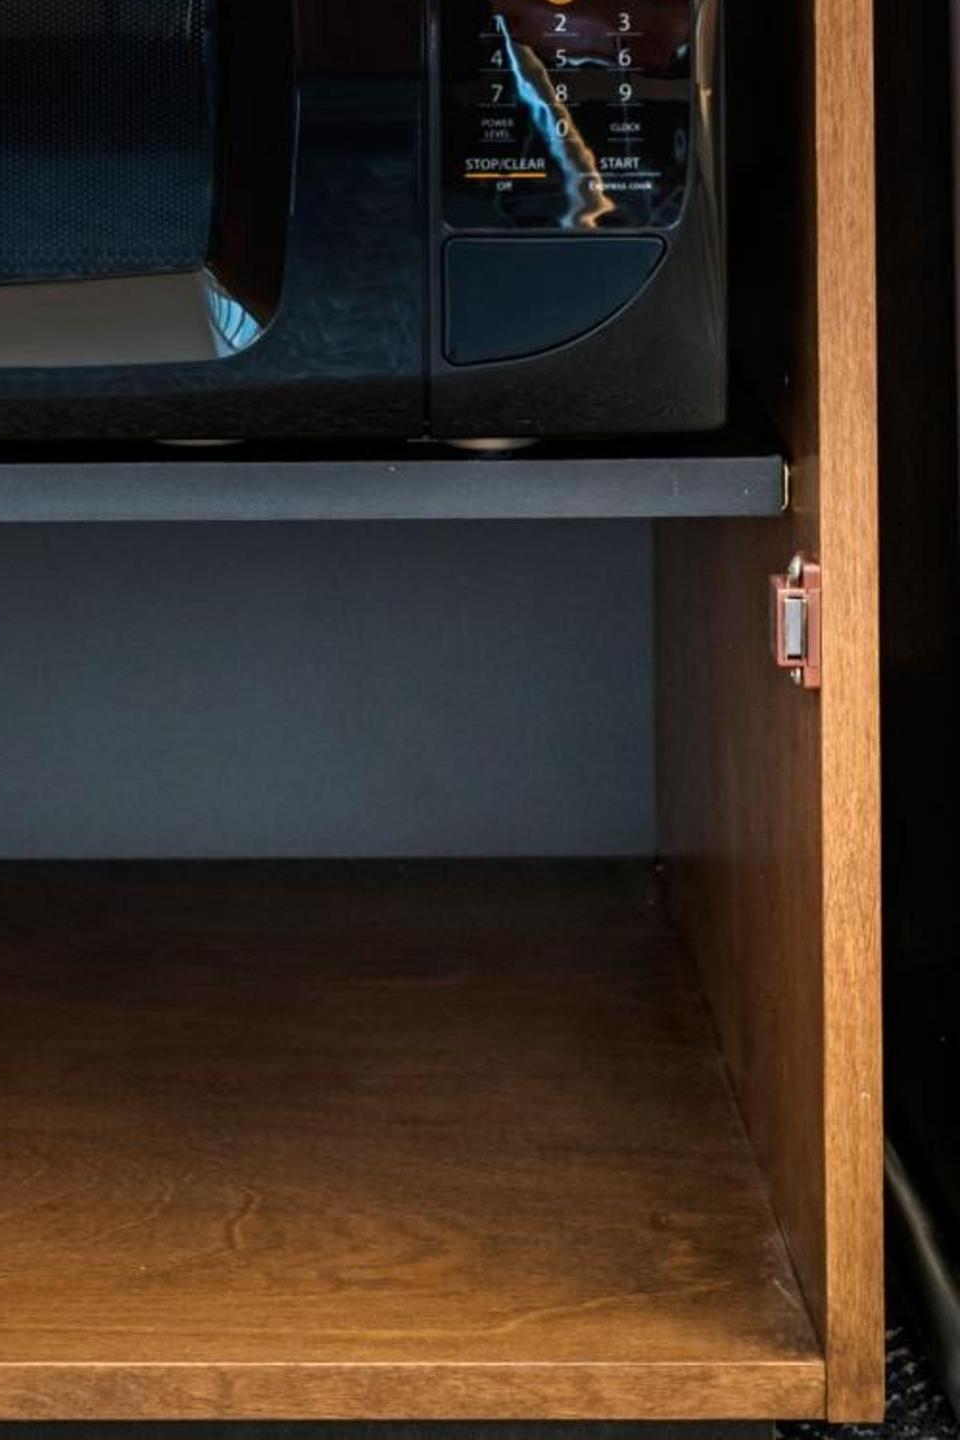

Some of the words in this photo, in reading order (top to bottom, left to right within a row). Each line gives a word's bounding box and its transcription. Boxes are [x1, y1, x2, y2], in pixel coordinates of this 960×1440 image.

[554, 13, 567, 32] 2
[618, 13, 631, 32] 3
[490, 49, 503, 67] 4
[555, 49, 567, 67] 5
[618, 48, 631, 66] 6
[491, 84, 504, 102] 7
[555, 83, 568, 102] 8
[618, 83, 632, 102] 9
[481, 118, 514, 127] POWER
[555, 119, 568, 137] 0
[609, 122, 641, 132] CLOCK
[484, 129, 510, 139] LEVEL
[465, 158, 545, 171] STOP/CLEAR
[600, 156, 640, 170] START
